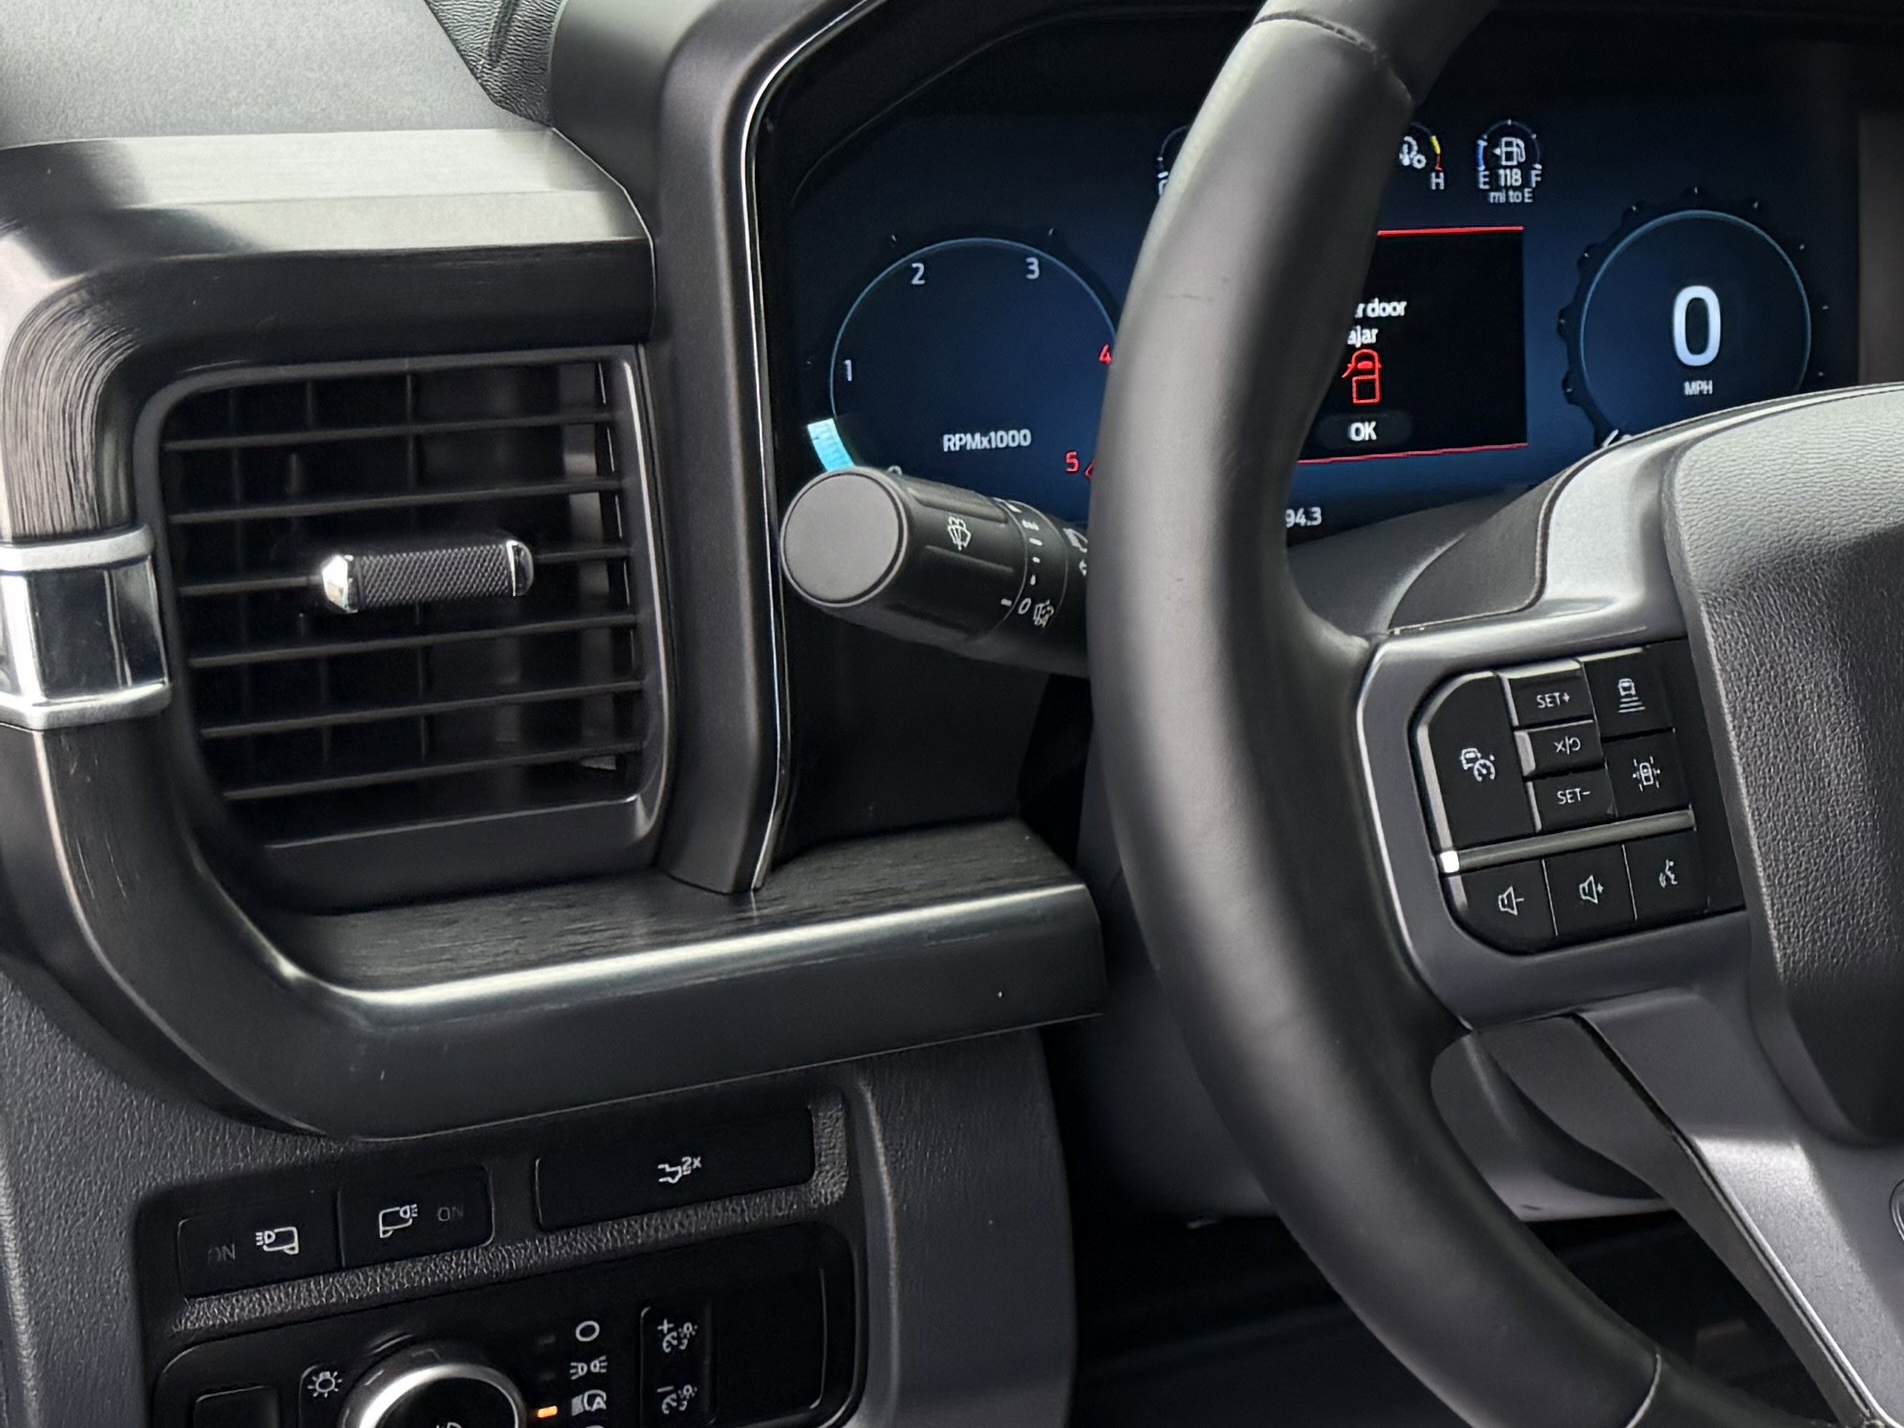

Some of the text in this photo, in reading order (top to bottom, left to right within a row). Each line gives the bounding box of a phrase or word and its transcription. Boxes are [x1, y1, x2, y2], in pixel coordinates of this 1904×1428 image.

[1498, 169, 1522, 187] 118
[911, 262, 926, 285] 2
[1025, 257, 1040, 280] 3
[1369, 299, 1408, 318] door
[1672, 285, 1721, 367] 0
[1347, 328, 1379, 348] ajar
[1099, 344, 1112, 365] 4
[843, 359, 853, 382] 1
[1684, 380, 1713, 396] MPH
[943, 429, 1032, 452] RPMx1000
[1348, 421, 1378, 442] OK
[1065, 452, 1080, 472] 5
[1285, 508, 1323, 527] 94.3
